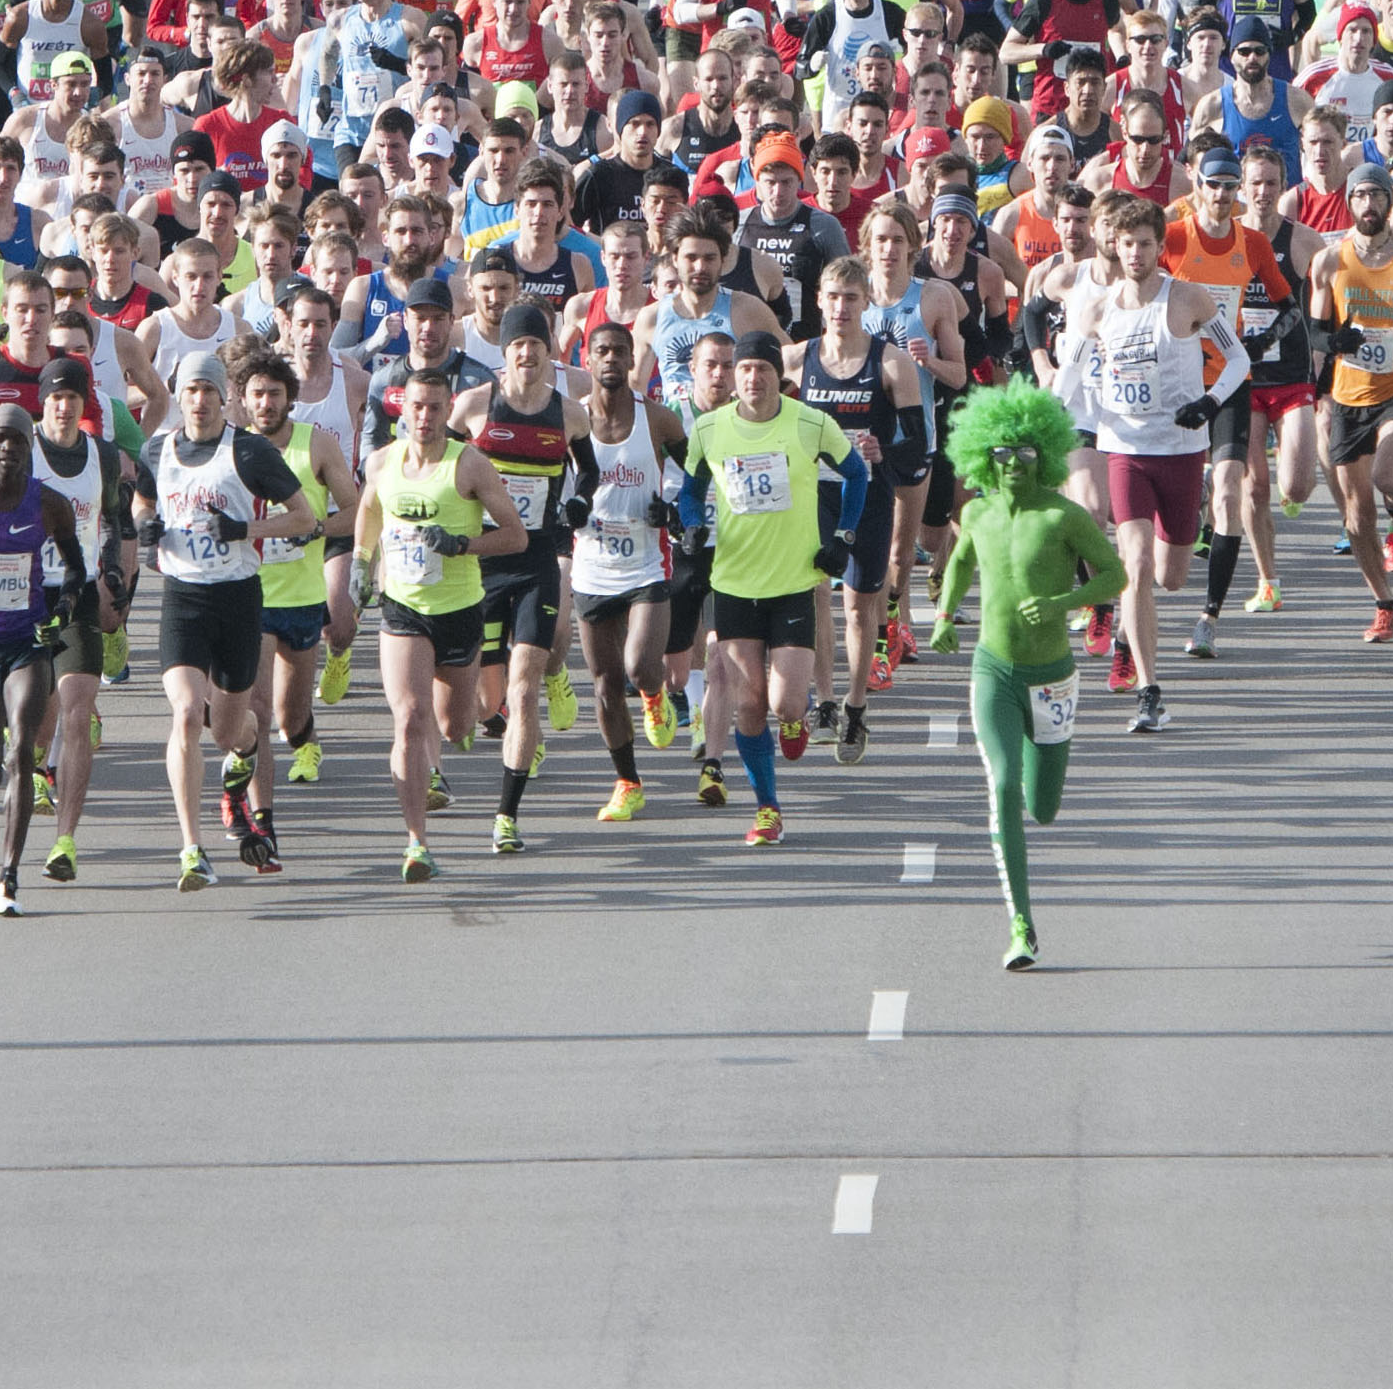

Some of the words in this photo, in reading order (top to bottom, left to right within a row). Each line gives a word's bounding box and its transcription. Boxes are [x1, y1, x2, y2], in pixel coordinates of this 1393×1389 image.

[357, 85, 378, 104] 71
[756, 237, 793, 250] new
[806, 389, 874, 402] ILLINOIS
[1111, 383, 1152, 404] 208
[744, 472, 773, 497] 18
[399, 544, 426, 568] 14
[595, 535, 635, 558] 130
[1050, 698, 1075, 726] 32
